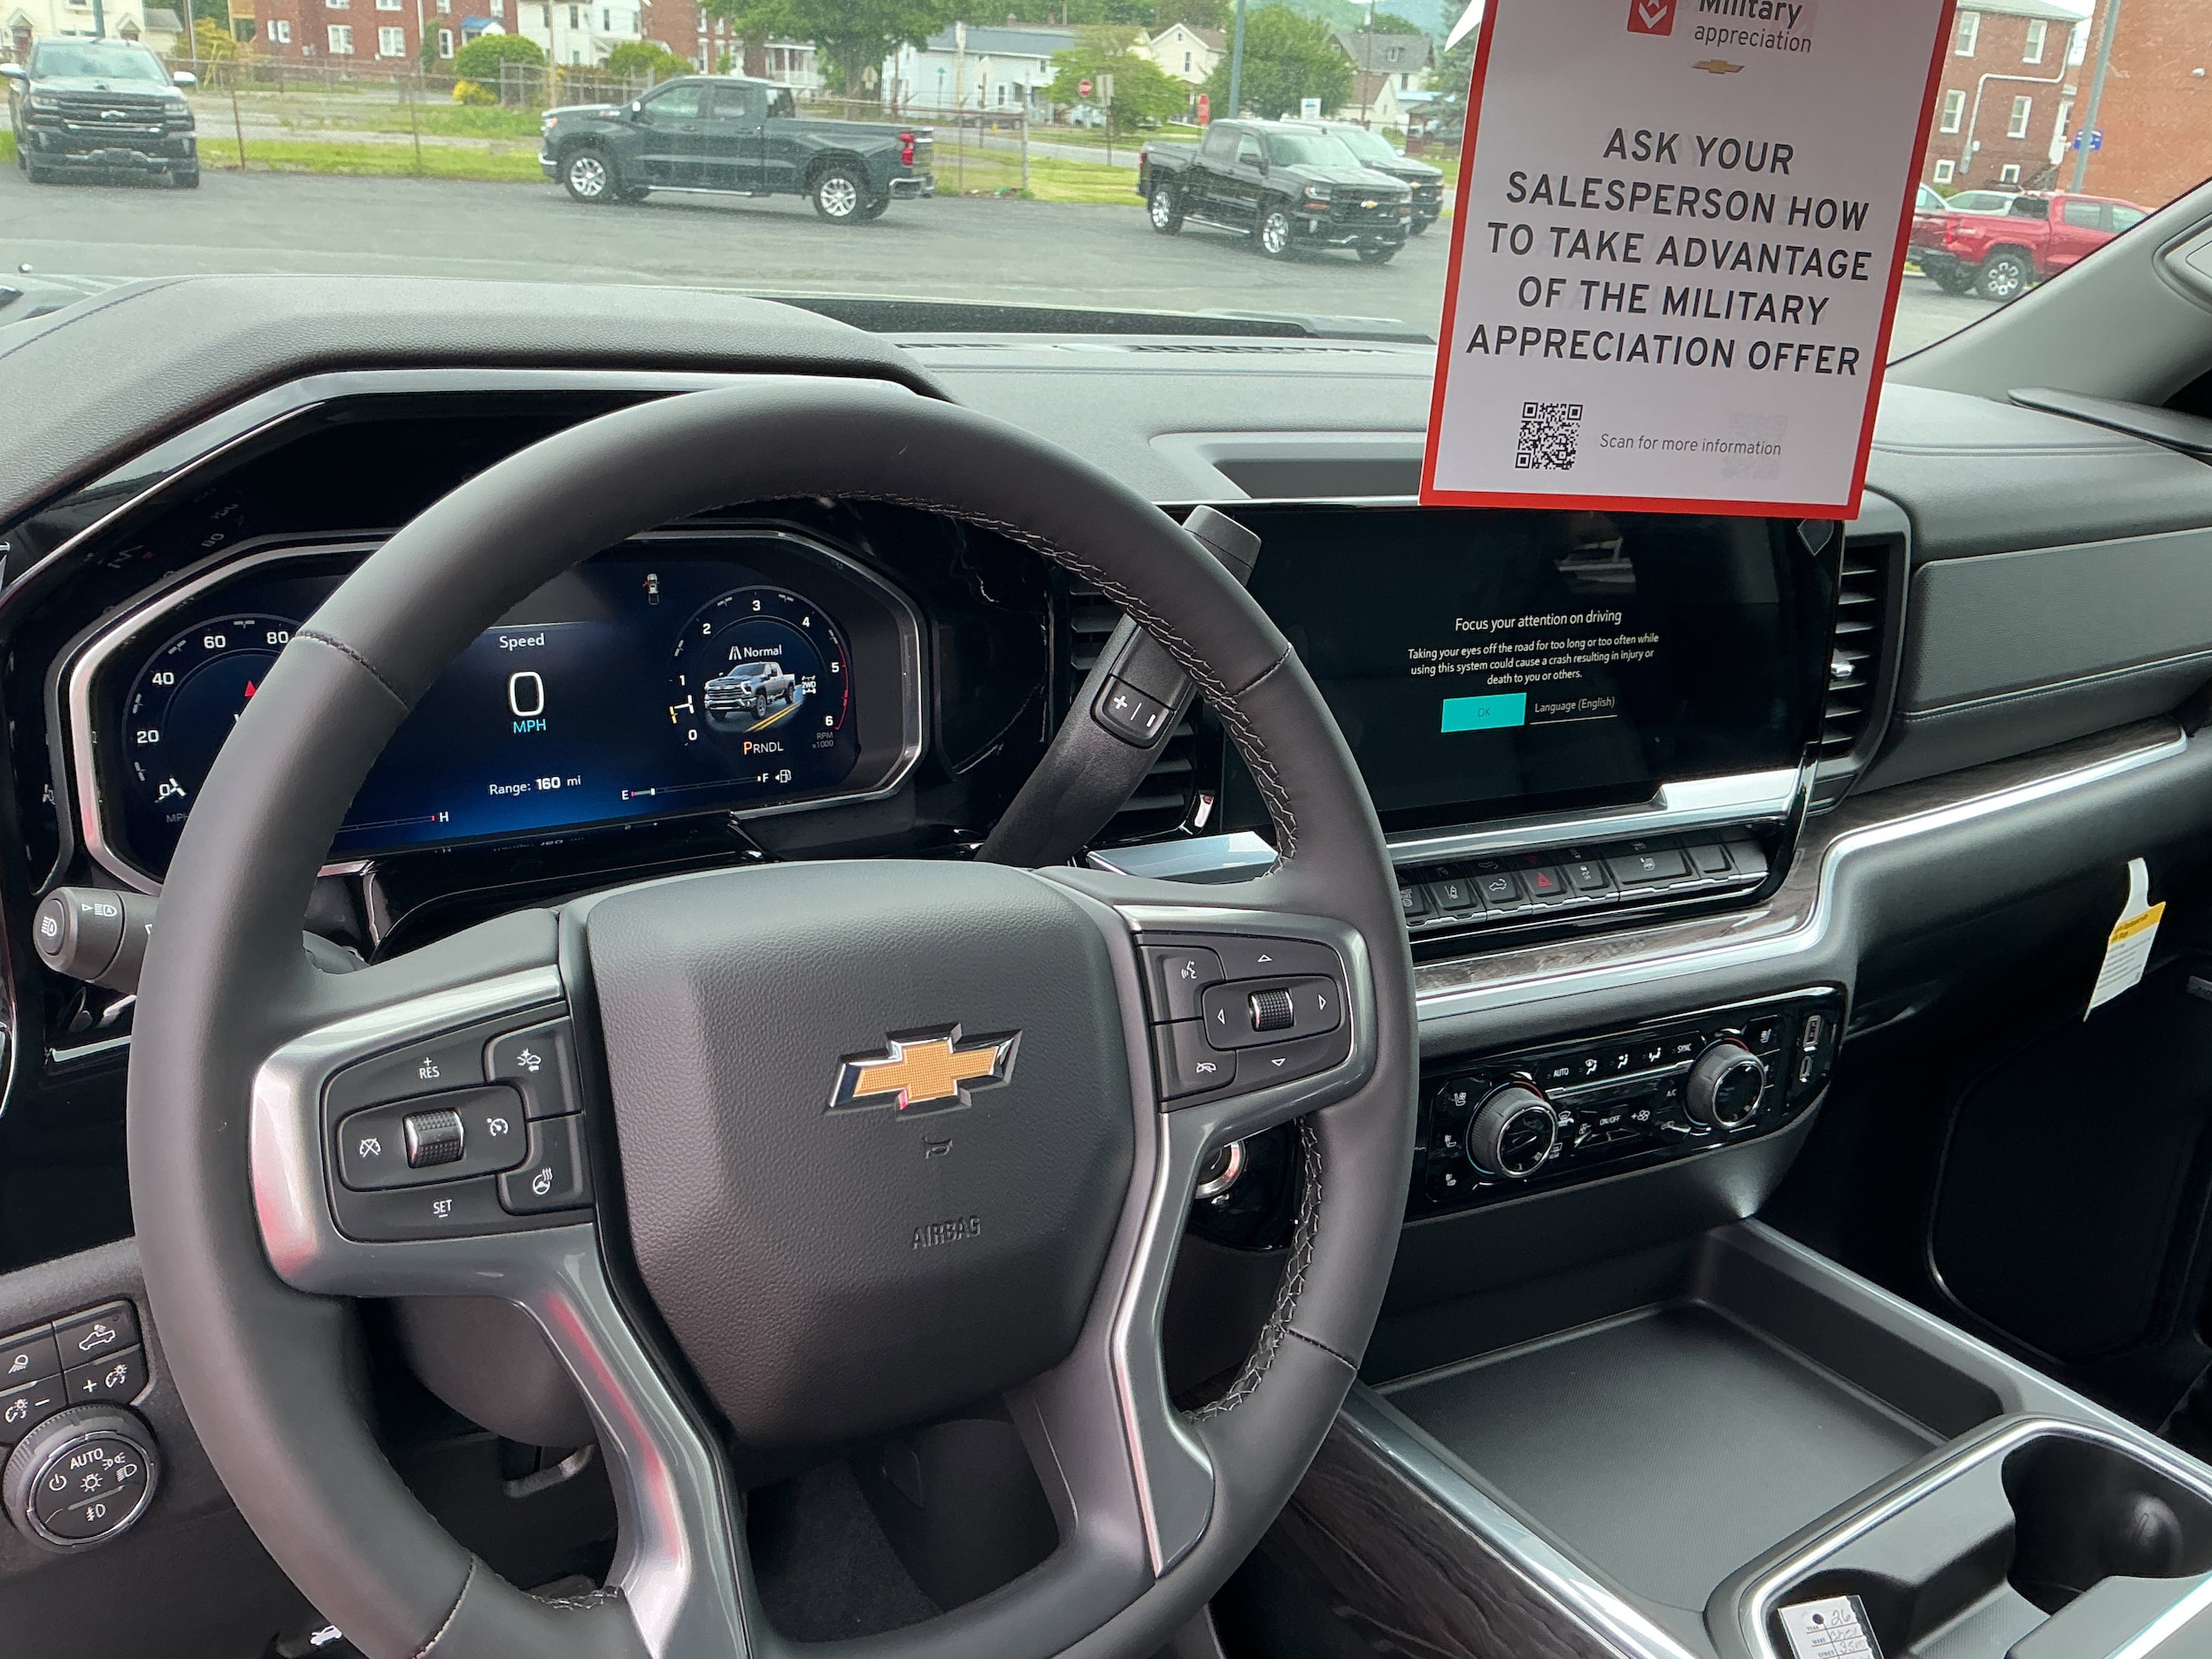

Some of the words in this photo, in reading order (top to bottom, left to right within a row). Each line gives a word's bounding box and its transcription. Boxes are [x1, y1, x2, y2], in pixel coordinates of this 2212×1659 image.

[1699, 0, 1802, 29] Military
[1694, 25, 1812, 53] appreciation
[1602, 127, 1680, 165] ASK
[1694, 134, 1794, 175] YOUR
[1506, 171, 1774, 225] SALESPERSON
[1788, 196, 1869, 232] HOW
[1487, 221, 1534, 256] TO
[1549, 226, 1644, 264] TAKE
[1656, 236, 1873, 281] ADVANTAGE
[1518, 276, 1566, 309] OF
[1579, 280, 1649, 314] THE
[1662, 287, 1829, 326] MILITARY
[1466, 324, 1735, 369] APPRECIATION
[1747, 341, 1860, 376] OFFER
[1599, 433, 1634, 449] Scan
[1638, 434, 1659, 450] for
[1662, 438, 1699, 452] more
[1701, 438, 1781, 456] information
[752, 601, 761, 611] 3
[703, 623, 711, 634] 2
[802, 616, 810, 627] 4
[1455, 618, 1488, 632] Focus
[1490, 618, 1517, 634] your
[1517, 612, 1568, 628] attention
[1570, 612, 1583, 625] on
[1586, 610, 1622, 626] driving
[204, 634, 227, 649] 60
[266, 630, 289, 644] 80
[498, 632, 545, 651] Speed
[743, 644, 782, 658] Normal
[1408, 649, 1438, 661] Taking
[1438, 649, 1460, 661] your
[1461, 646, 1481, 659] eyes
[1483, 642, 1498, 655] off
[1498, 641, 1513, 654] the
[1514, 640, 1535, 653] road
[1536, 639, 1549, 650] for
[1550, 640, 1565, 649] too
[1566, 638, 1586, 651] long
[1598, 637, 1613, 646] too
[1614, 634, 1636, 645] often
[1637, 632, 1659, 644] while
[831, 662, 840, 673] 5
[1410, 664, 1436, 677] using
[1438, 662, 1455, 673] this
[1456, 661, 1487, 674] system
[1489, 657, 1515, 669] could
[1515, 657, 1540, 668] cause
[1541, 657, 1548, 666] a
[1548, 653, 1572, 664] crash
[1573, 651, 1609, 664] resulting
[1611, 650, 1619, 661] in
[1620, 649, 1644, 662] injury
[1645, 649, 1655, 658] or
[152, 672, 174, 686] 40
[680, 675, 686, 686] 1
[1486, 672, 1513, 685] death
[1514, 673, 1523, 683] to
[1524, 673, 1540, 685] you
[1541, 672, 1552, 680] or
[1553, 668, 1582, 680] others.
[509, 672, 545, 717] 0
[1478, 707, 1491, 718] OK
[1534, 701, 1576, 714] Language
[1578, 695, 1616, 710] (English)
[512, 718, 547, 734] MPH
[825, 715, 833, 726] 6
[136, 729, 159, 744] 20
[688, 729, 697, 741] 0
[743, 741, 784, 755] PRNDL
[811, 739, 834, 749] x1000
[763, 772, 769, 783] F
[488, 781, 531, 797] Range:
[535, 776, 561, 791] 160
[567, 775, 581, 787] mi
[621, 789, 629, 800] E
[439, 810, 449, 824] H
[419, 1066, 441, 1079] RES
[1553, 1067, 1570, 1078] AUTO
[1665, 1088, 1677, 1097] A/C
[433, 1199, 453, 1214] SET
[911, 1214, 982, 1250] AIRBAG
[69, 1447, 104, 1471] AUTO
